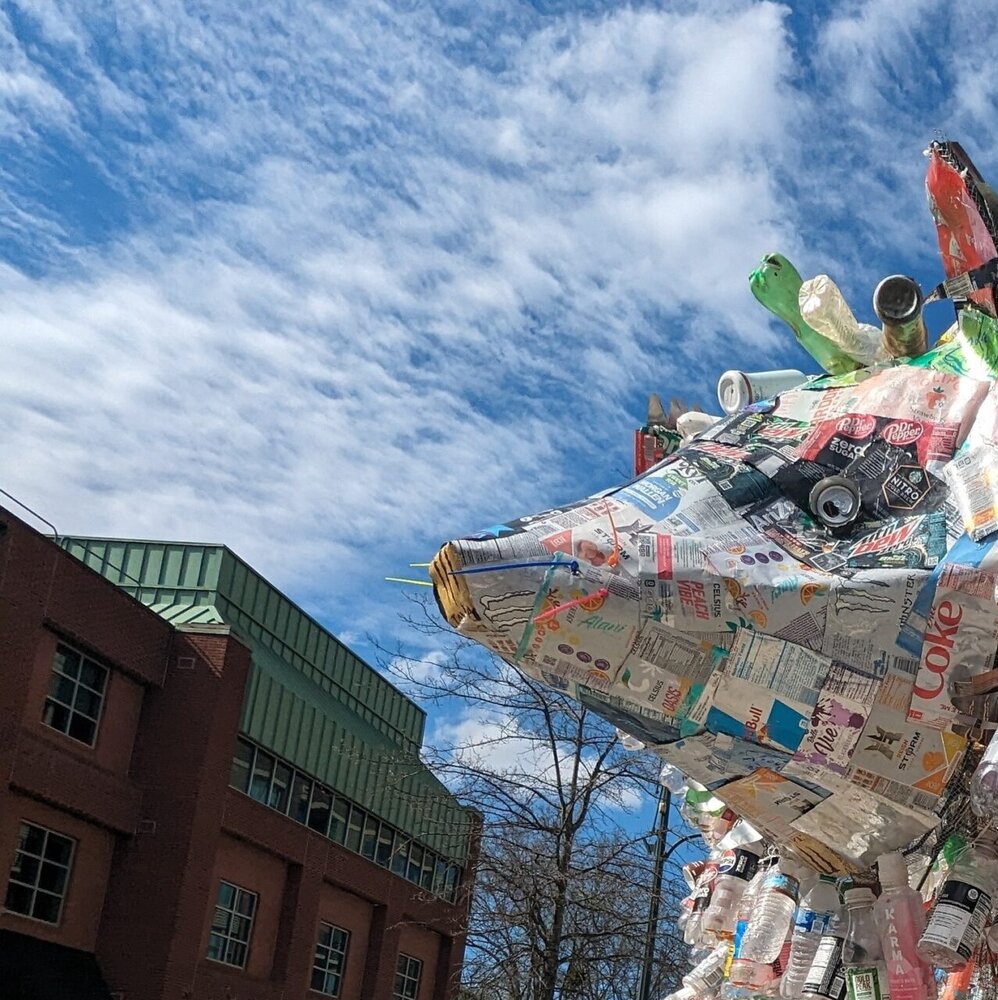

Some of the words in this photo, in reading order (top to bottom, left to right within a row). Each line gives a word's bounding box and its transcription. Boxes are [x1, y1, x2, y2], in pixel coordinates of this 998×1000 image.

[838, 418, 873, 435] Pepper
[851, 416, 863, 427] Dr
[886, 426, 921, 442] Pepper
[900, 422, 914, 431] Dr
[831, 437, 862, 454] zero
[889, 476, 920, 501] NITRO
[677, 580, 694, 607] VIBE
[689, 580, 710, 621] PEACH
[713, 583, 722, 618] CELSIUS
[913, 600, 963, 700] Coke
[648, 680, 665, 702] CELSIUS
[662, 685, 683, 712] OASIS
[745, 706, 763, 730] Bull
[813, 725, 838, 756] Vie
[898, 731, 921, 771] STORM
[886, 908, 906, 975] KARMA
